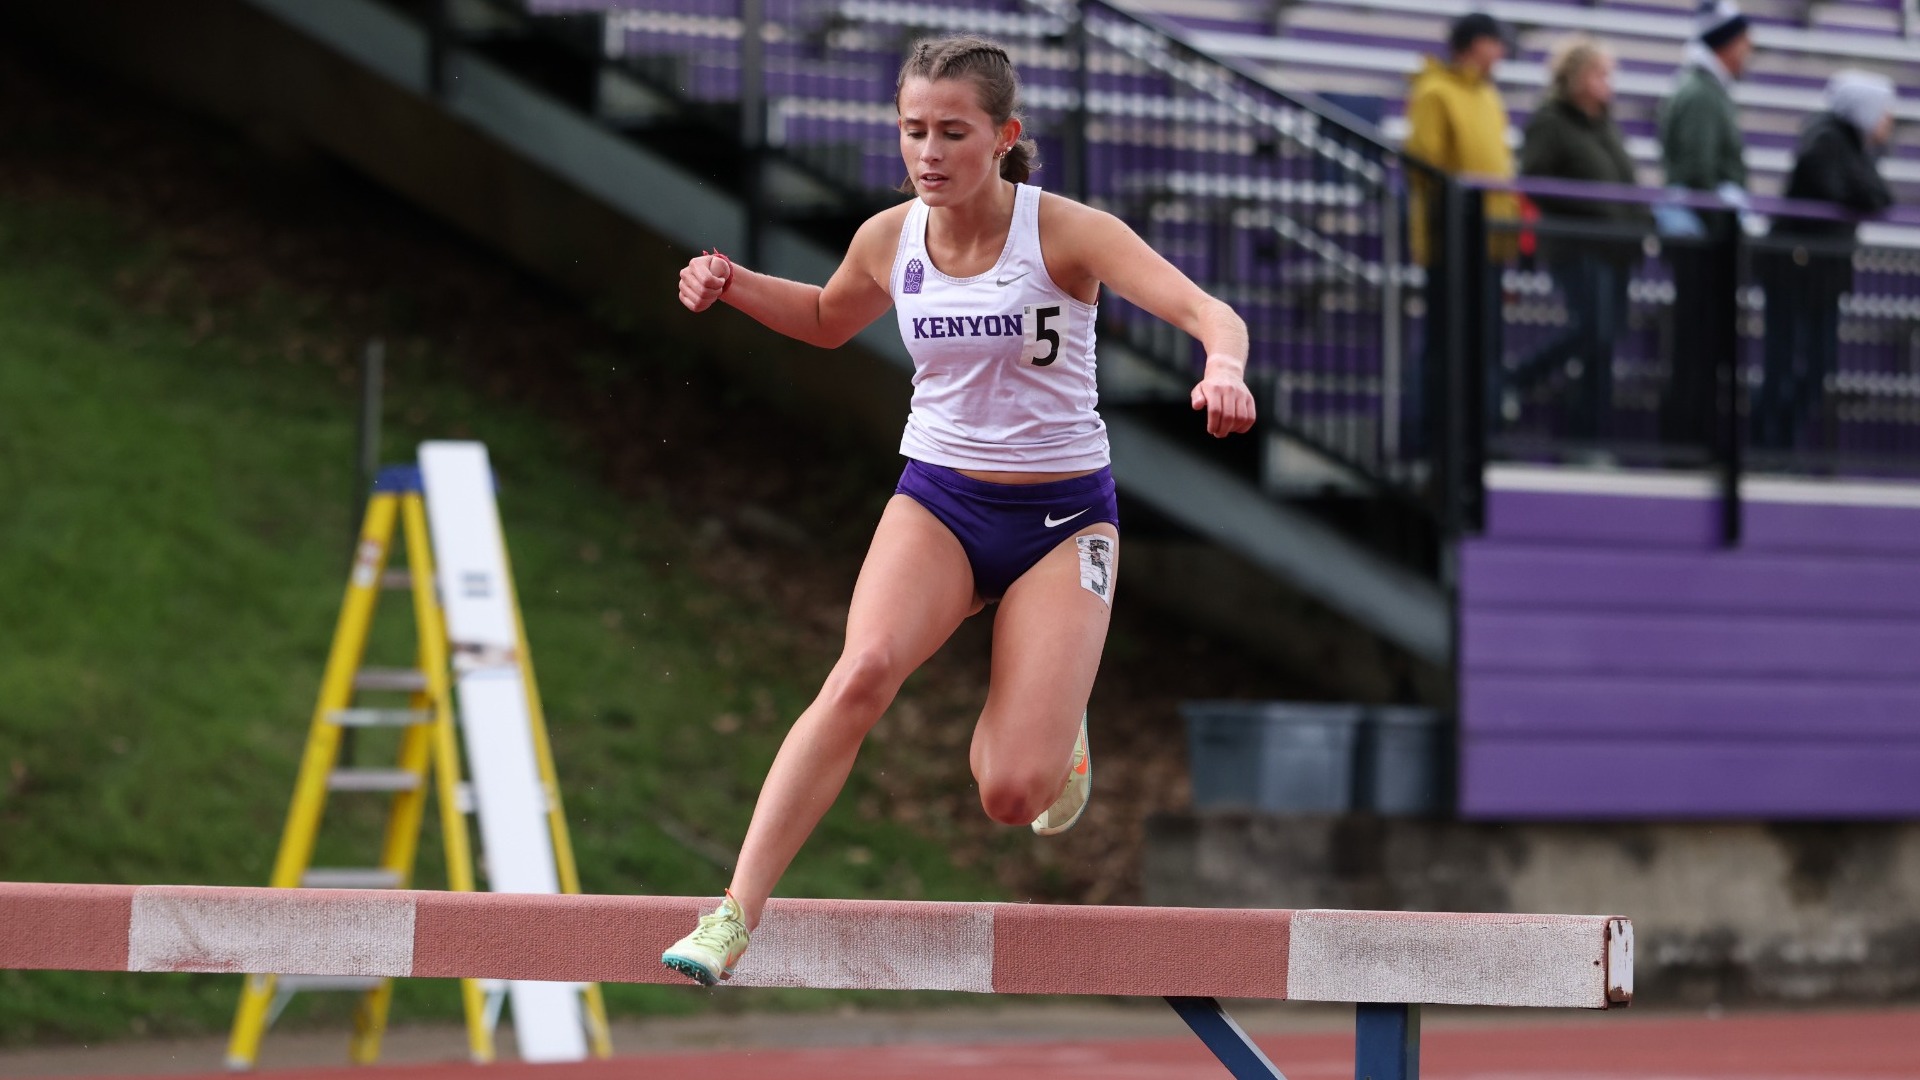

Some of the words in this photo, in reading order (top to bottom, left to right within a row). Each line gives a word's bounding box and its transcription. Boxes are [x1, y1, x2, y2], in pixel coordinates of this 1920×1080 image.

[912, 314, 1023, 339] KENYON
[1031, 306, 1060, 367] 5
[1089, 539, 1110, 596] 5
